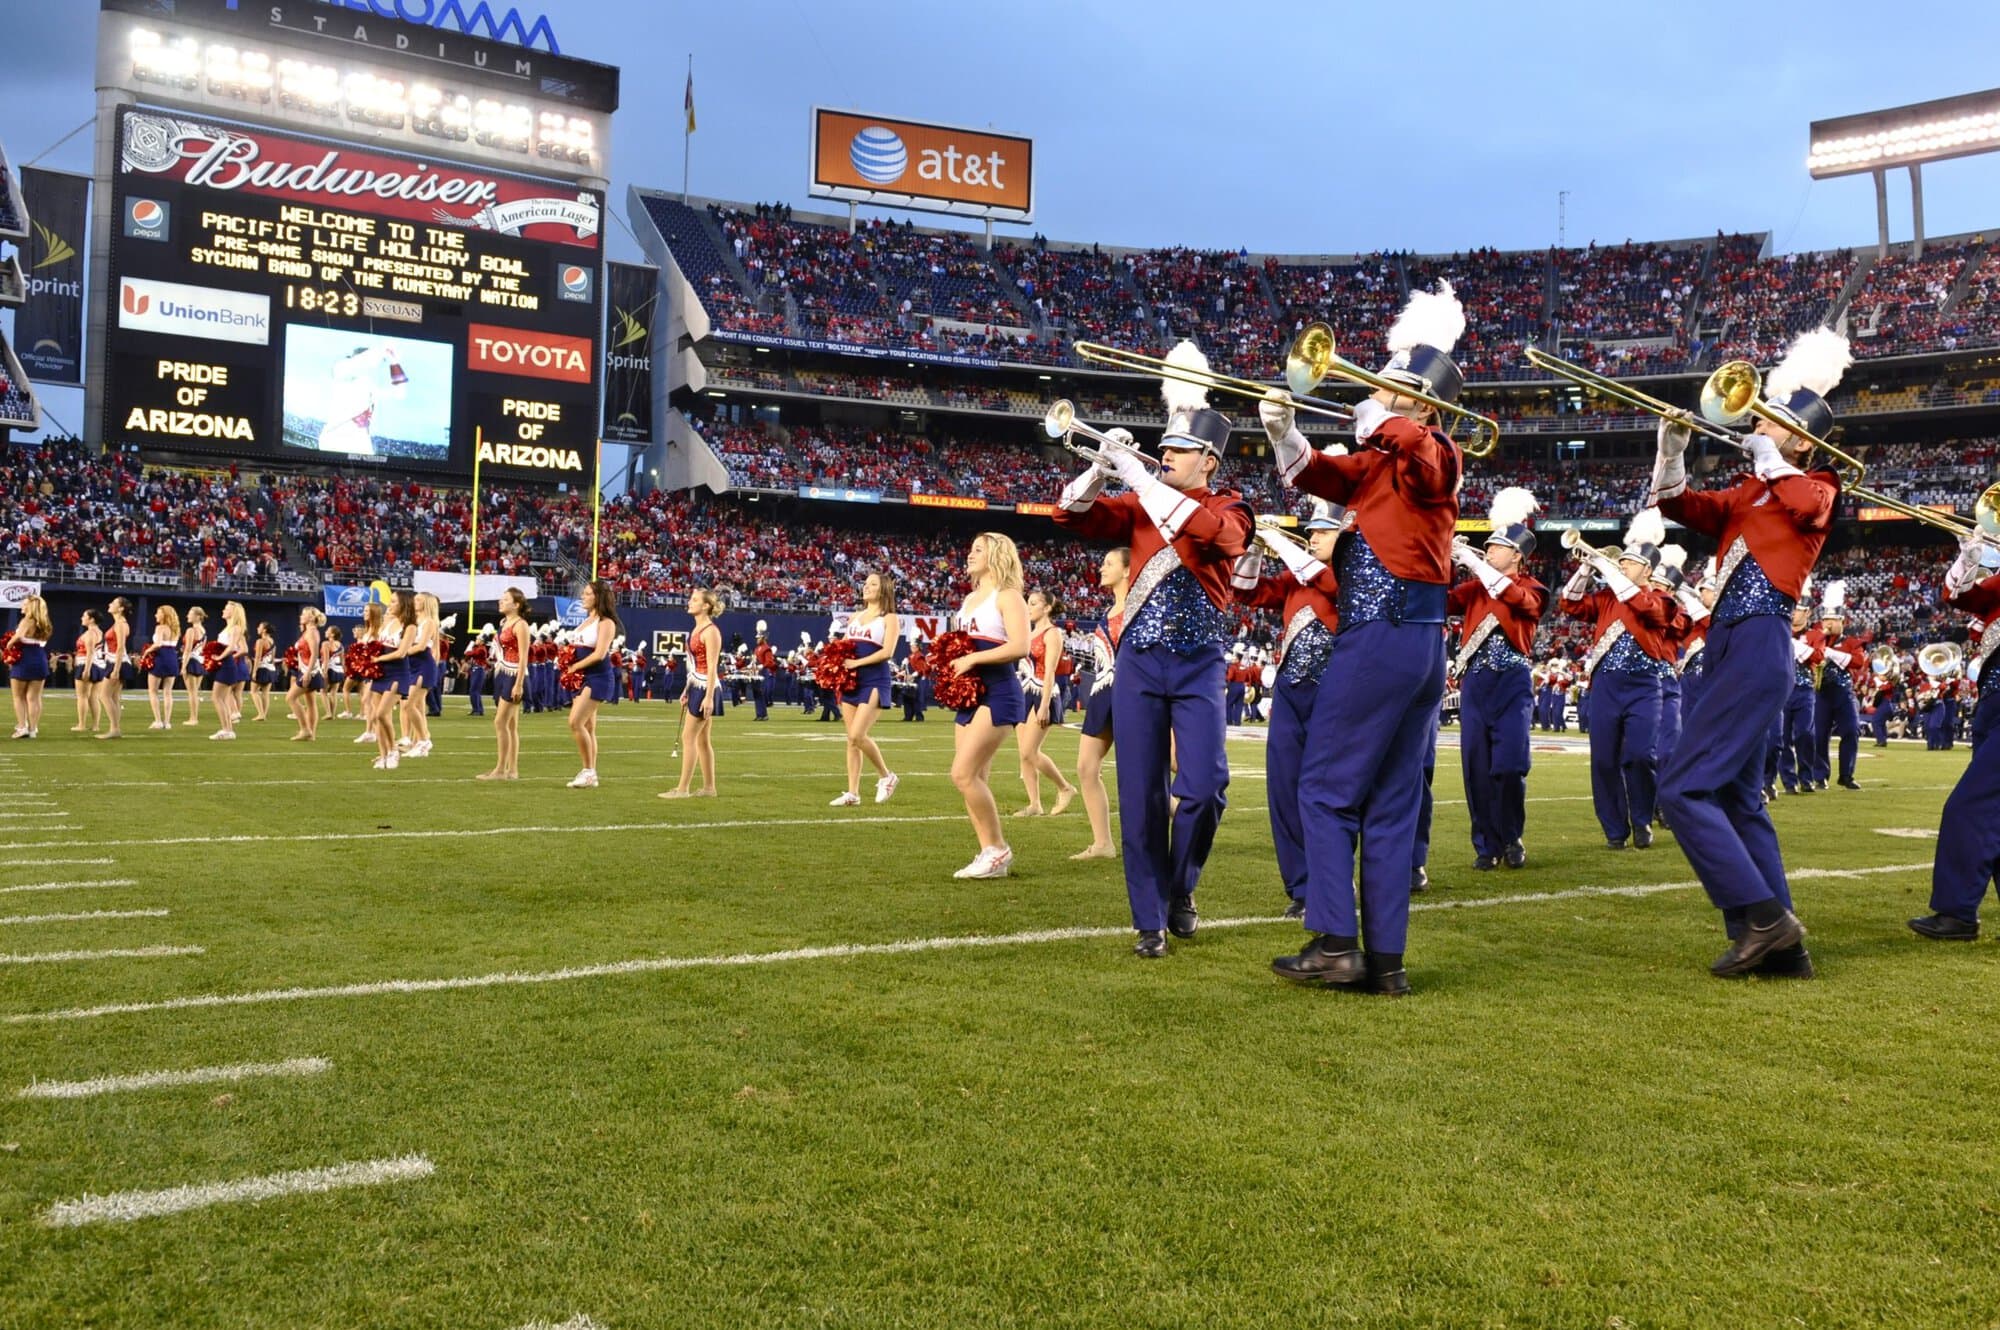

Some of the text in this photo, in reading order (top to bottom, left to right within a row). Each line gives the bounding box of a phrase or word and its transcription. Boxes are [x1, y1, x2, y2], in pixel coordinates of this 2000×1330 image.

[270, 8, 531, 76] STADIUM
[169, 137, 496, 205] Budweiser
[918, 145, 1005, 190] at&t
[281, 205, 465, 249] WELCOME TO THE
[500, 206, 595, 225] American Lager
[133, 227, 161, 239] pepsi
[202, 211, 530, 277] PACIFIC LIFE HOLIDAY BOWL
[214, 234, 520, 291] PRE-GAME SHOW PRESENTED BY THE
[191, 248, 259, 271] SYCUAN
[268, 259, 312, 278] BAND
[321, 266, 343, 282] OF
[353, 270, 384, 288] THE
[480, 289, 538, 310] NATION
[160, 300, 266, 328] UnionBank
[287, 285, 358, 316] 18:23
[365, 301, 421, 318] SYCUAN
[475, 338, 586, 372] TOYOTA
[607, 352, 650, 371] Sprint
[738, 332, 751, 342] FAN
[752, 334, 782, 345] CONDUCT
[809, 340, 824, 349] TEXT
[889, 349, 906, 357] YOUR
[907, 351, 938, 361] LOCATION
[939, 354, 952, 362] AND
[972, 358, 980, 366] TO
[158, 360, 228, 385] PRIDE
[177, 387, 208, 406] OF
[503, 399, 561, 421] PRIDE
[125, 407, 254, 440] ARIZONA
[518, 423, 544, 440] OF
[478, 442, 583, 471] ARIZONA
[912, 495, 986, 509] WELLS FARGO
[326, 605, 364, 616] PACIFIC
[659, 633, 683, 653] 25
[915, 618, 938, 641] N
